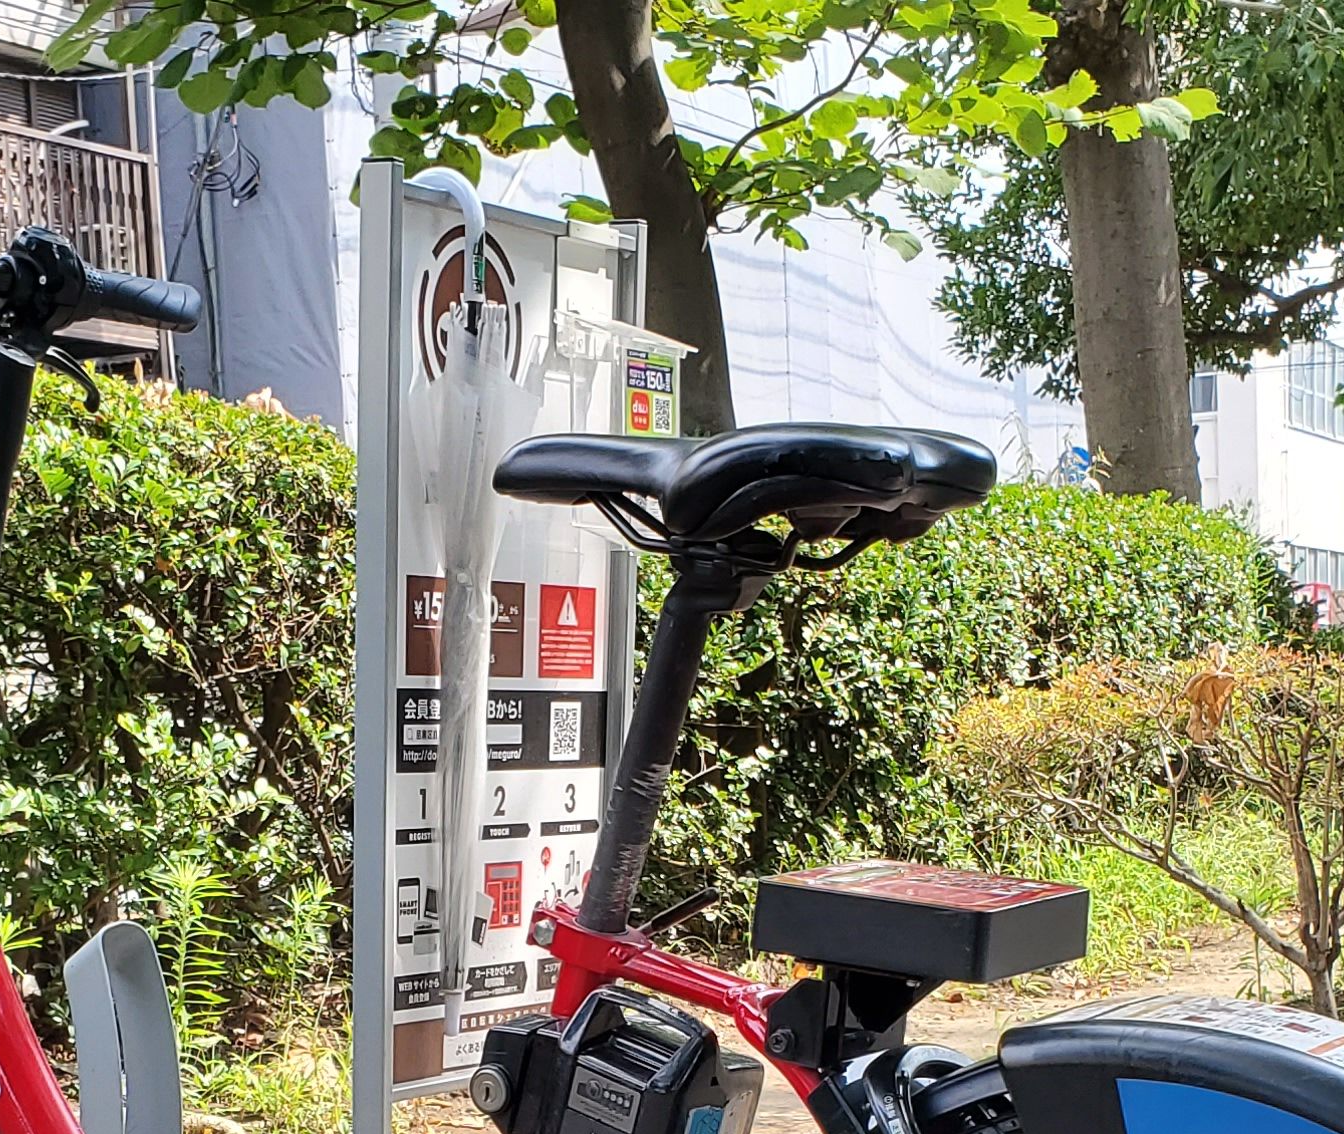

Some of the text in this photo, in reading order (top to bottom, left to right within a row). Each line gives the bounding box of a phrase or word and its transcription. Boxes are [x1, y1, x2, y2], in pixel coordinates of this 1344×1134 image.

[646, 371, 663, 391] 150
[419, 788, 427, 820] 1
[493, 785, 506, 817] 2
[564, 783, 576, 813] 3
